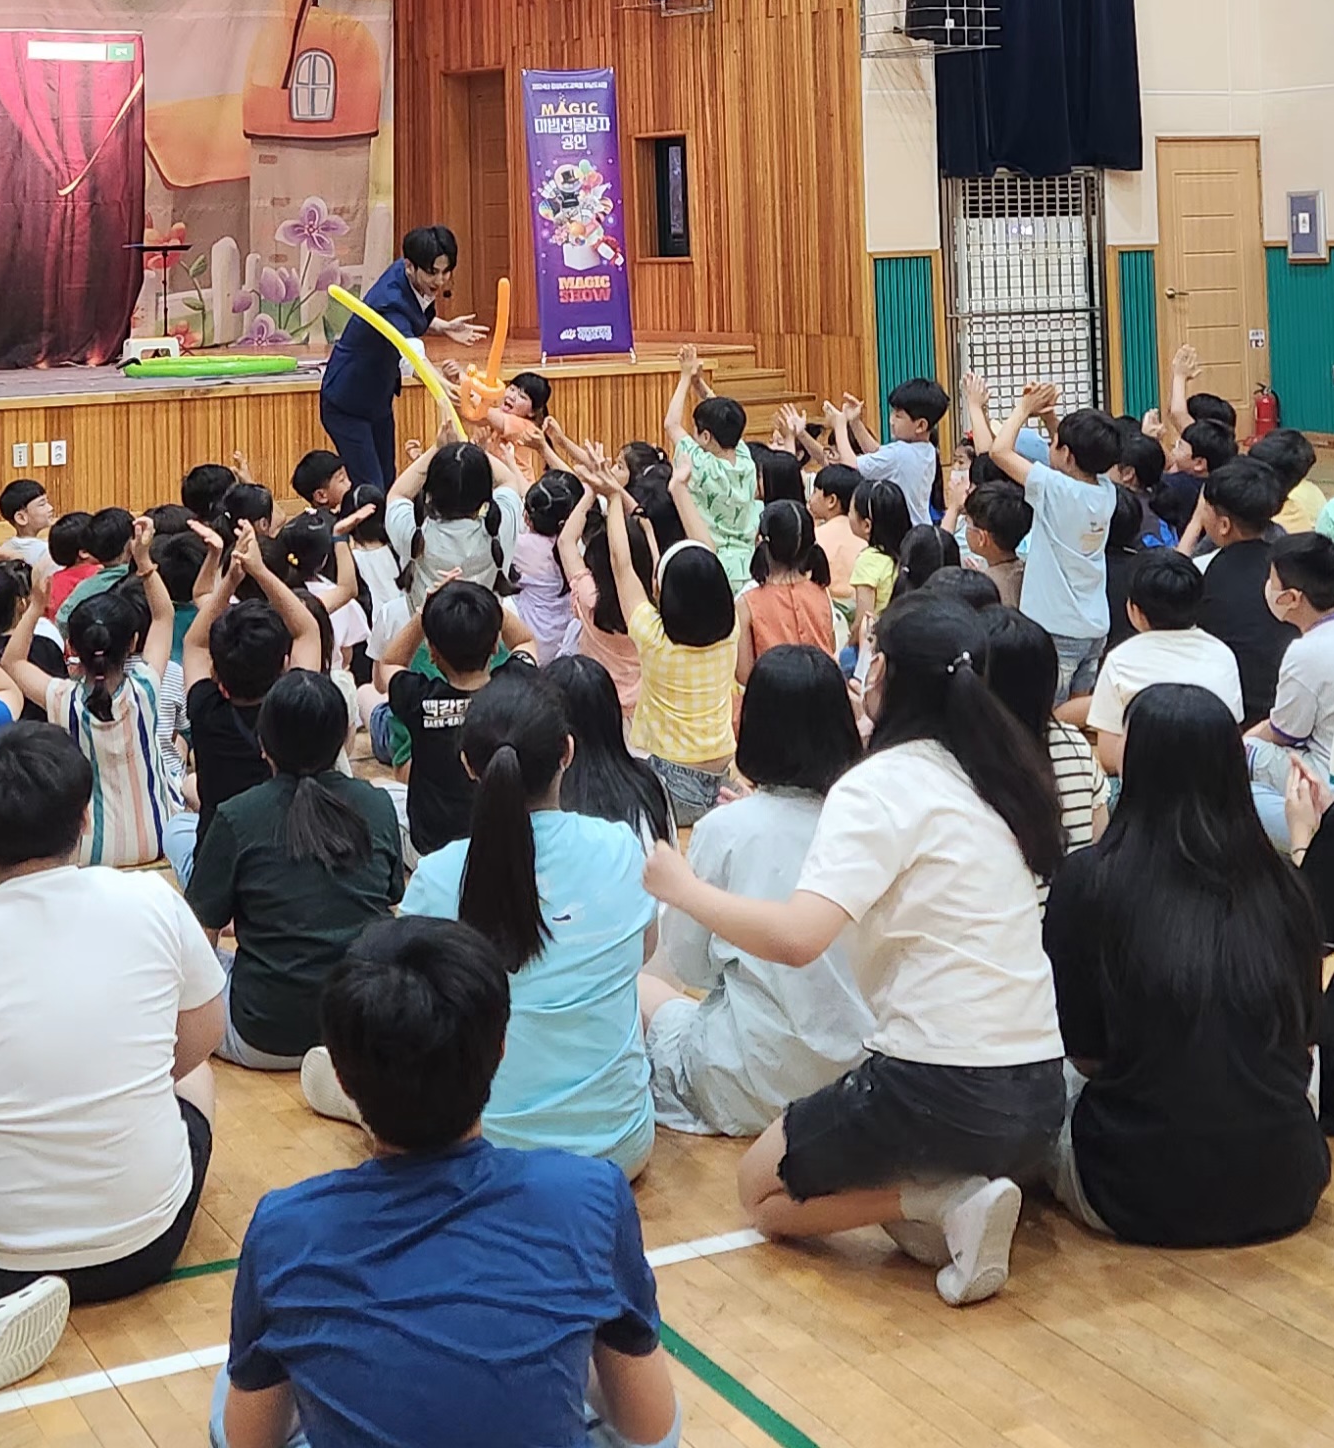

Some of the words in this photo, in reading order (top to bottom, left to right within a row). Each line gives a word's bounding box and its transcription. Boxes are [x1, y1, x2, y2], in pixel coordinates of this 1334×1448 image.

[541, 101, 599, 116] MAGIC
[558, 275, 611, 290] MAGIC
[559, 287, 612, 303] SHOW
